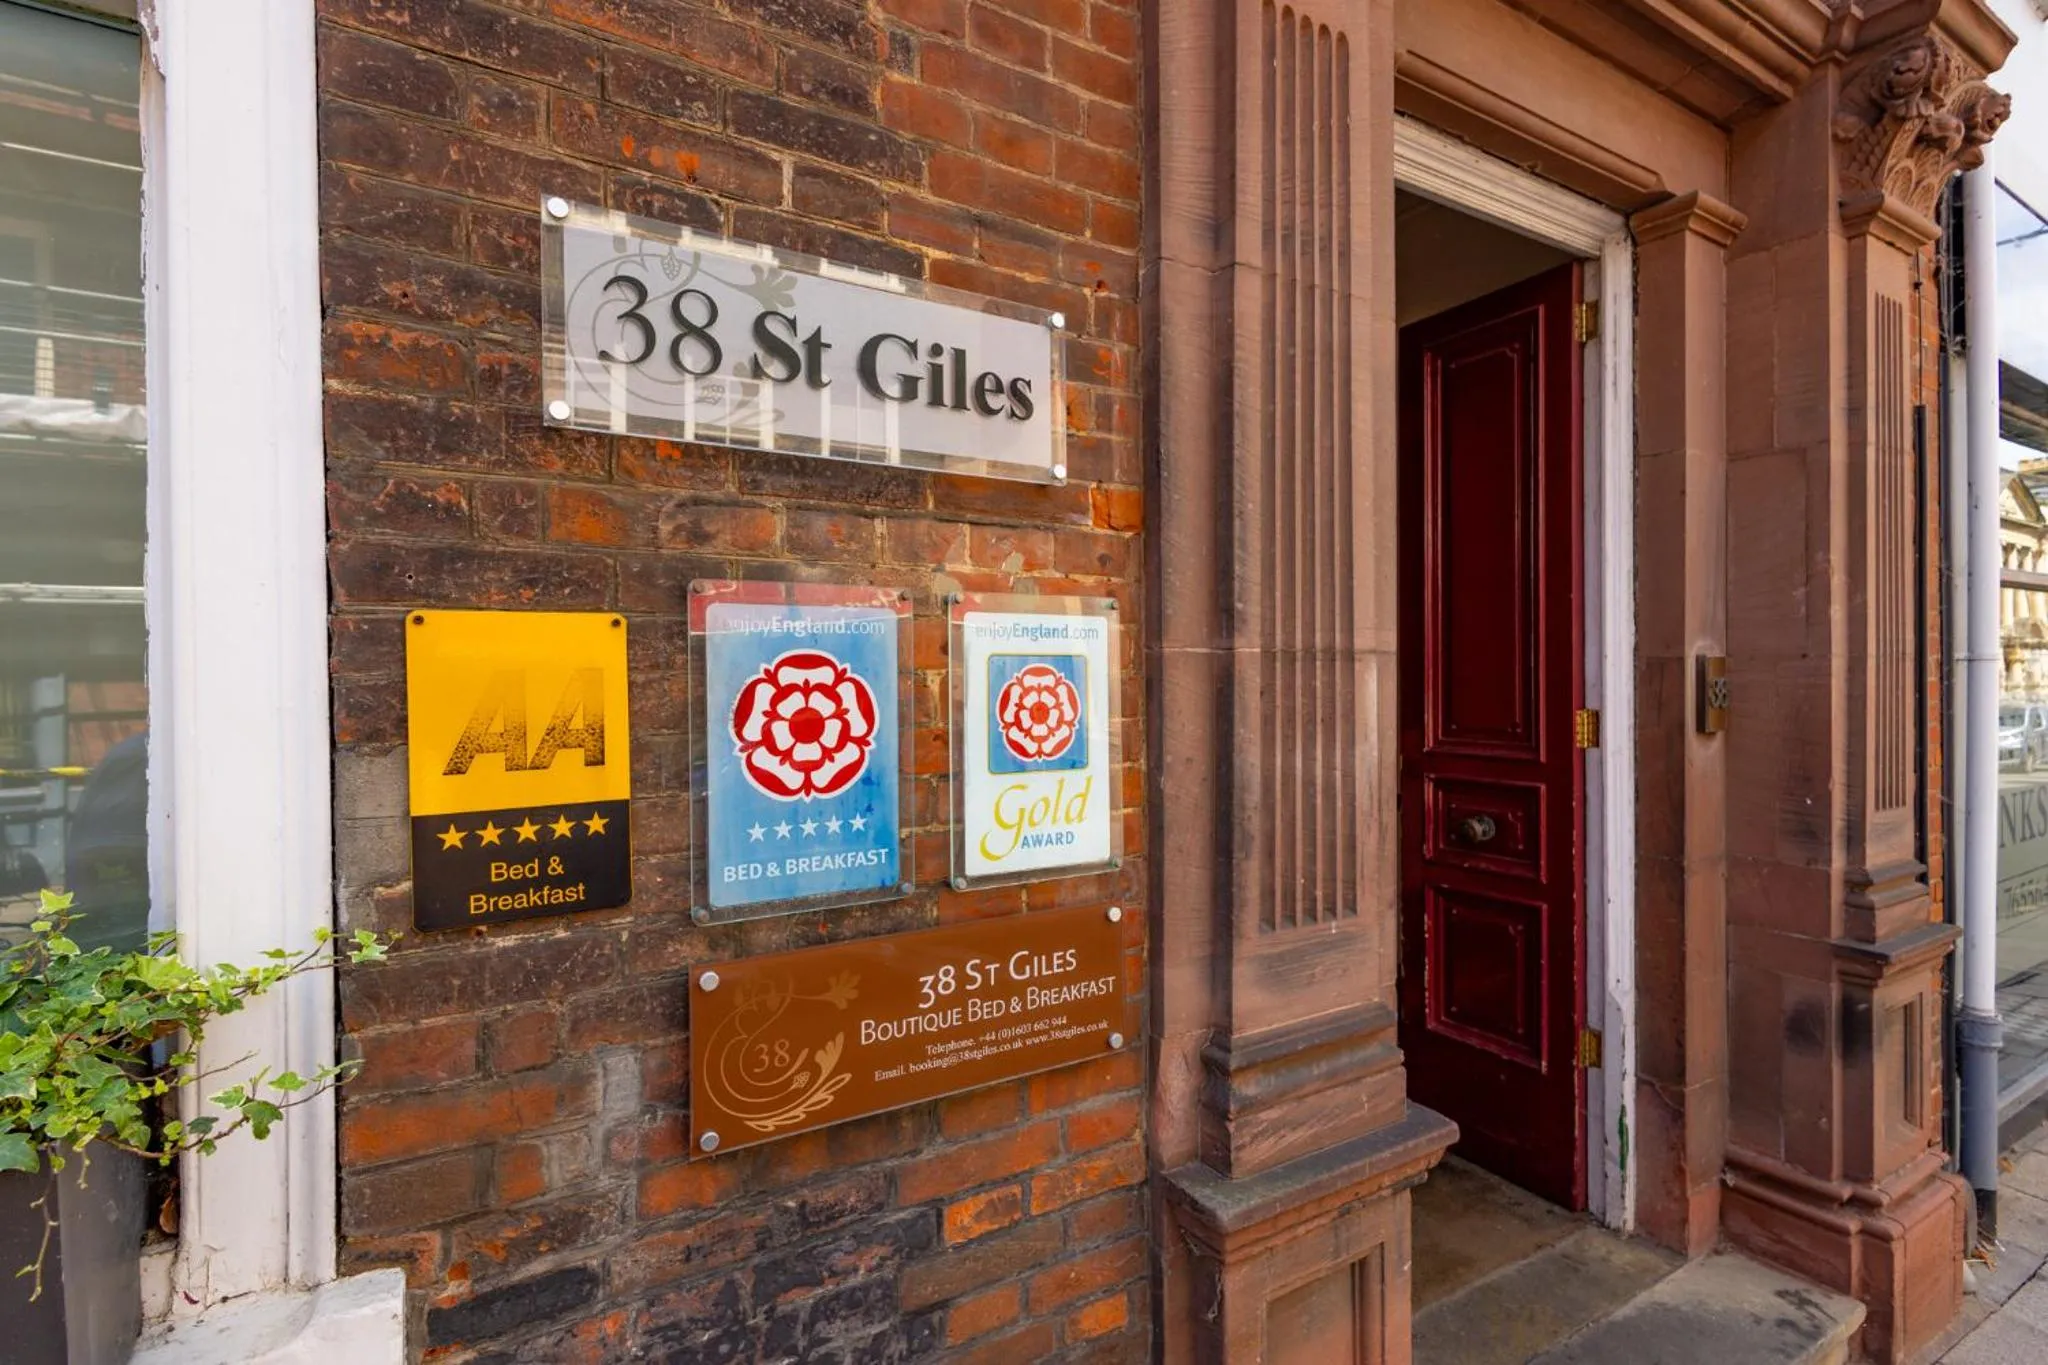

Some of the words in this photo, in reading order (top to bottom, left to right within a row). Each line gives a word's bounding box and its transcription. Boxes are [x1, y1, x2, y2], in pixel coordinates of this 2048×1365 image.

[599, 275, 723, 377] 38
[752, 310, 833, 390] St
[858, 333, 1034, 421] Giles
[975, 621, 1099, 642] enjoyEngland.com
[442, 667, 606, 776] AA
[980, 776, 1092, 862] Gold
[1021, 830, 1075, 850] AWARD
[490, 858, 539, 883] Bed
[547, 855, 565, 875] &
[723, 862, 762, 884] BED
[766, 860, 781, 878] &
[786, 848, 889, 875] BREAKFAST
[469, 882, 586, 915] Breakfast
[917, 964, 957, 1009] 38
[1009, 996, 1022, 1014] &
[753, 1038, 790, 1073] 38
